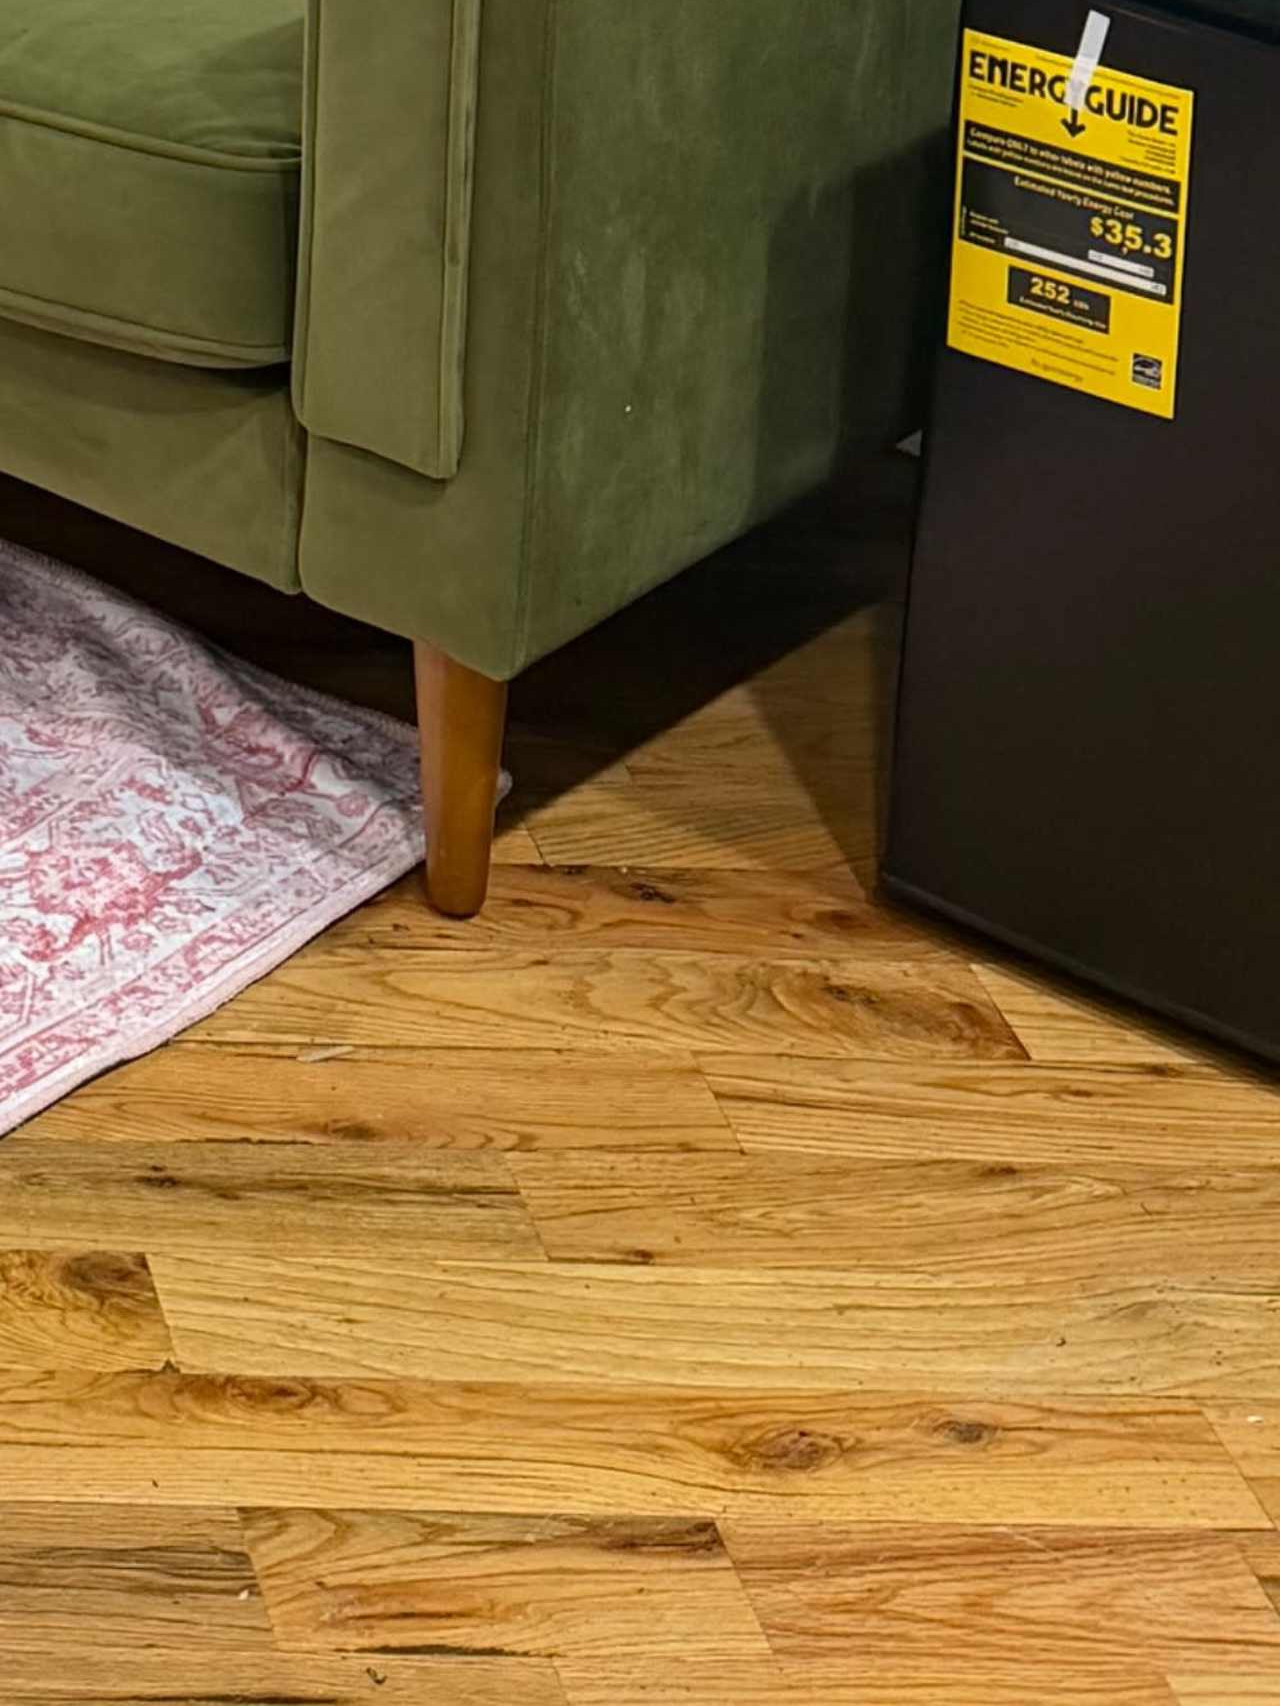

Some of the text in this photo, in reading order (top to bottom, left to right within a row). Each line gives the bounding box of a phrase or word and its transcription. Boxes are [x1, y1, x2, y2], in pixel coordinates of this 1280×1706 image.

[969, 50, 1082, 111] ENERG
[1084, 85, 1178, 136] GUIDE
[1030, 276, 1070, 304] 252
